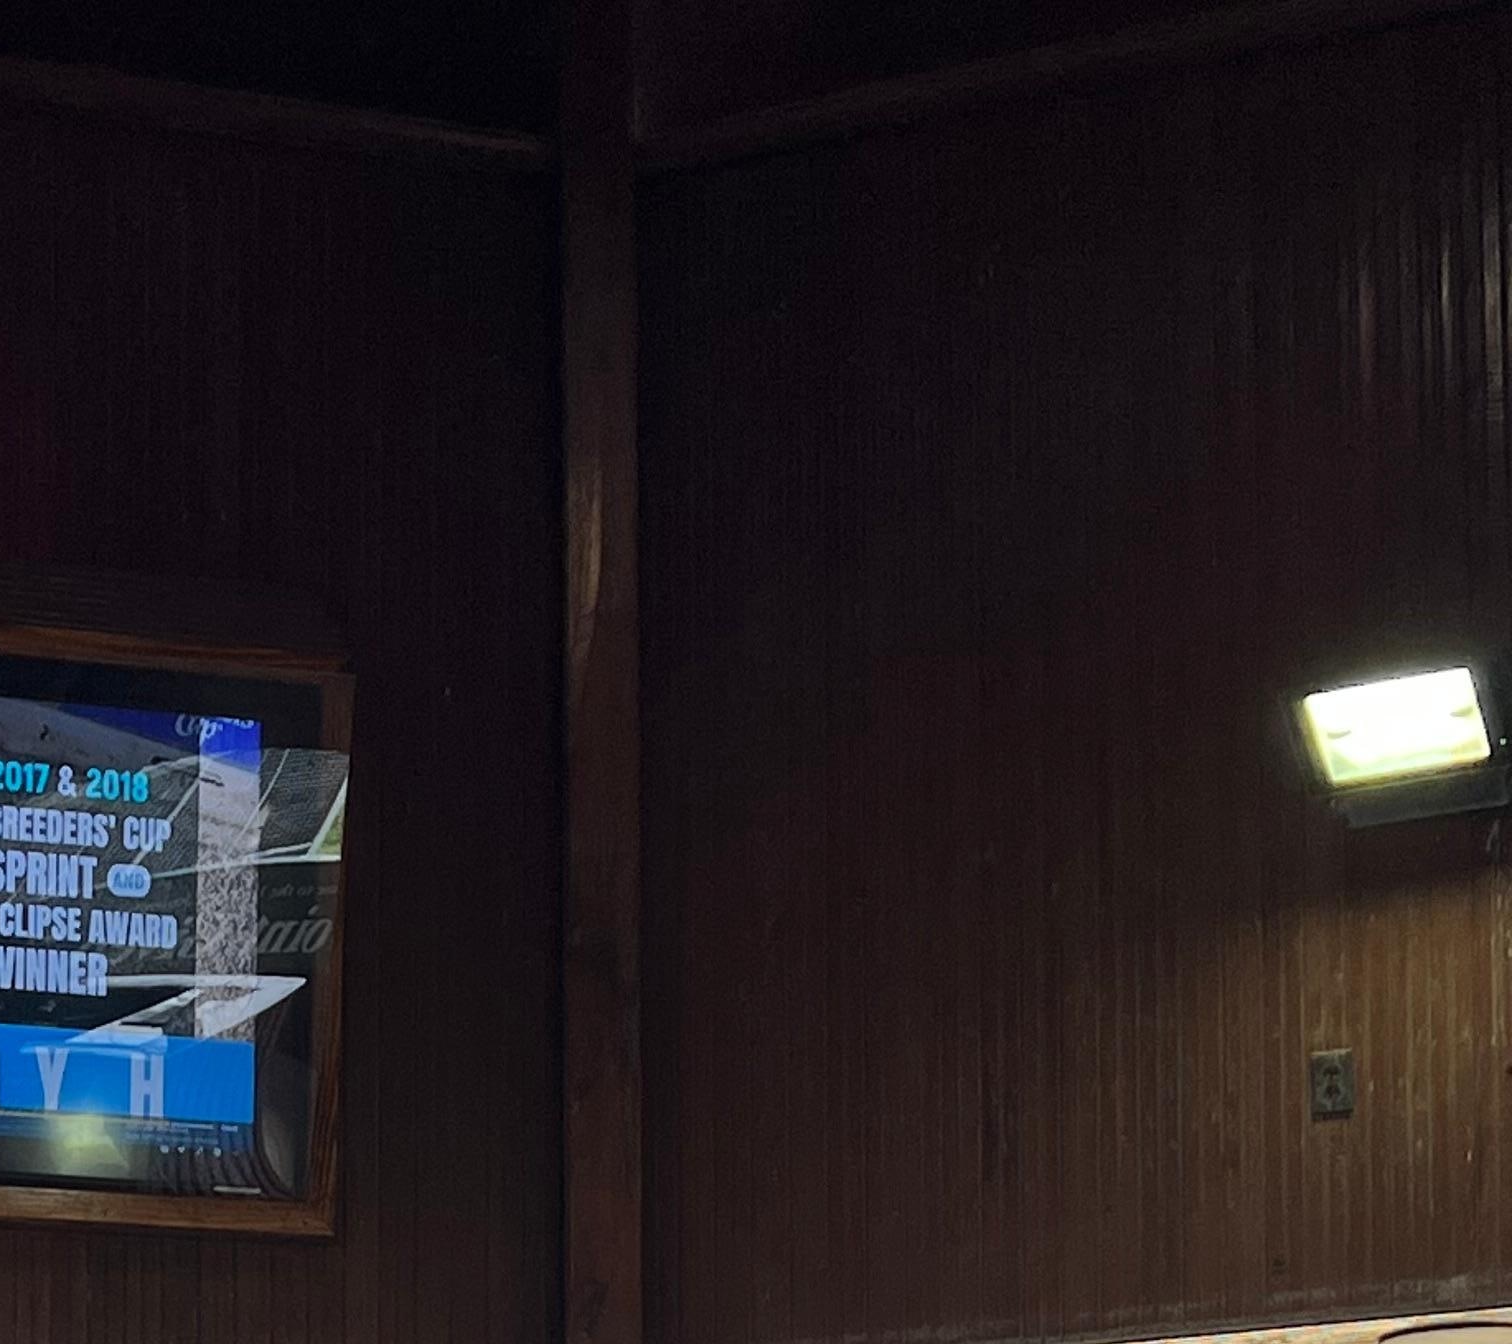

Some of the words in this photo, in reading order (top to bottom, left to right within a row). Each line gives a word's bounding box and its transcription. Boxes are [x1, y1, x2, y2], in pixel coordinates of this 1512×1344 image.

[58, 765, 77, 798] &
[85, 767, 148, 802] 2018
[123, 816, 172, 852] CUP
[113, 872, 145, 890] AND
[89, 909, 178, 949] AWARD
[130, 1052, 164, 1119] H
